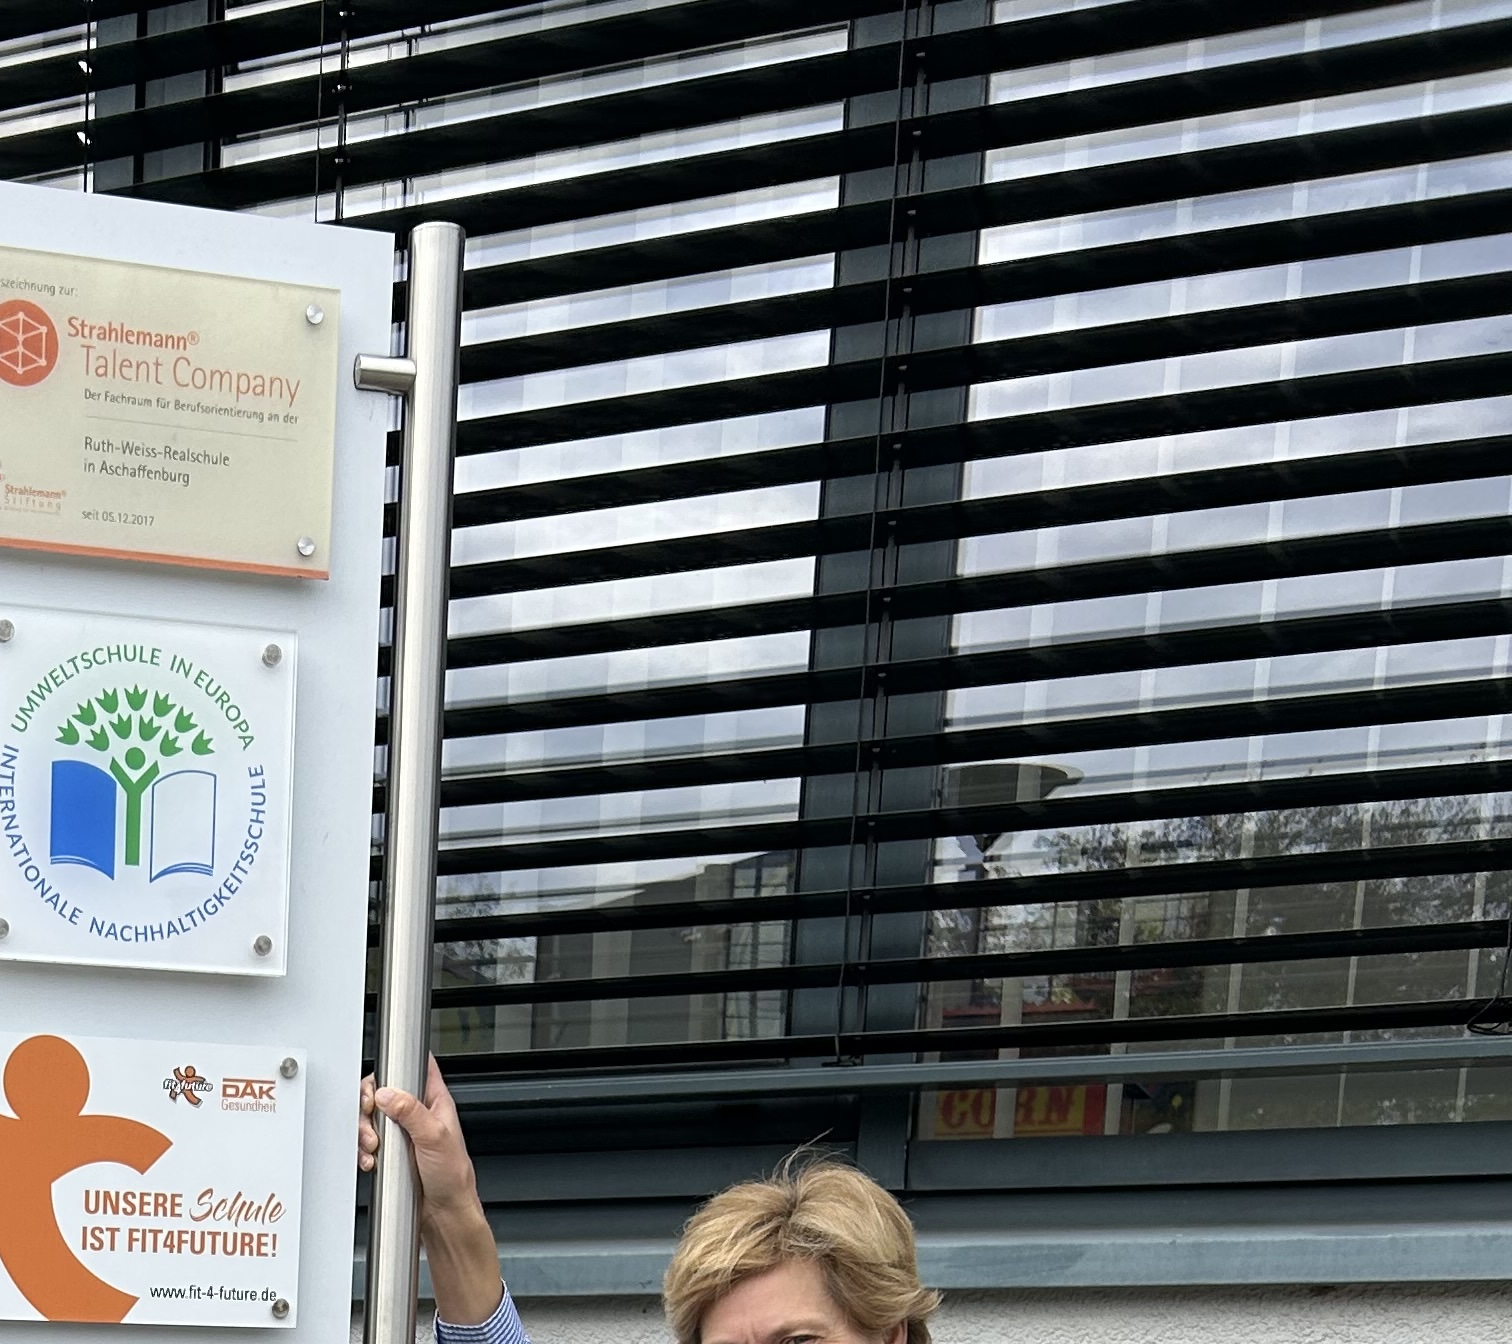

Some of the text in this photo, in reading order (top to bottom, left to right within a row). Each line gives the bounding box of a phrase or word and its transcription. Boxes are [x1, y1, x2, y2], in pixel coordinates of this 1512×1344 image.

[80, 344, 300, 408] Talent Company
[85, 388, 298, 424] Der Fachraum für Berufsorientierung an der
[84, 436, 230, 467] Ruth-Weiss-Realschule
[83, 458, 190, 487] in Aschaffenburg
[82, 510, 154, 526] seit 05.12.2017
[10, 644, 255, 751] UMWELTSCHULE IN EUROPA
[89, 764, 266, 943] NACHHALTIGKEITSSCHULE
[222, 1078, 276, 1100] DAK
[221, 1099, 276, 1113] Gesundheit
[84, 1187, 287, 1228] UNSERE Schule
[81, 1225, 278, 1258] IST FIT4FUTURE!
[150, 1285, 277, 1302] www.fit-4-future.de
